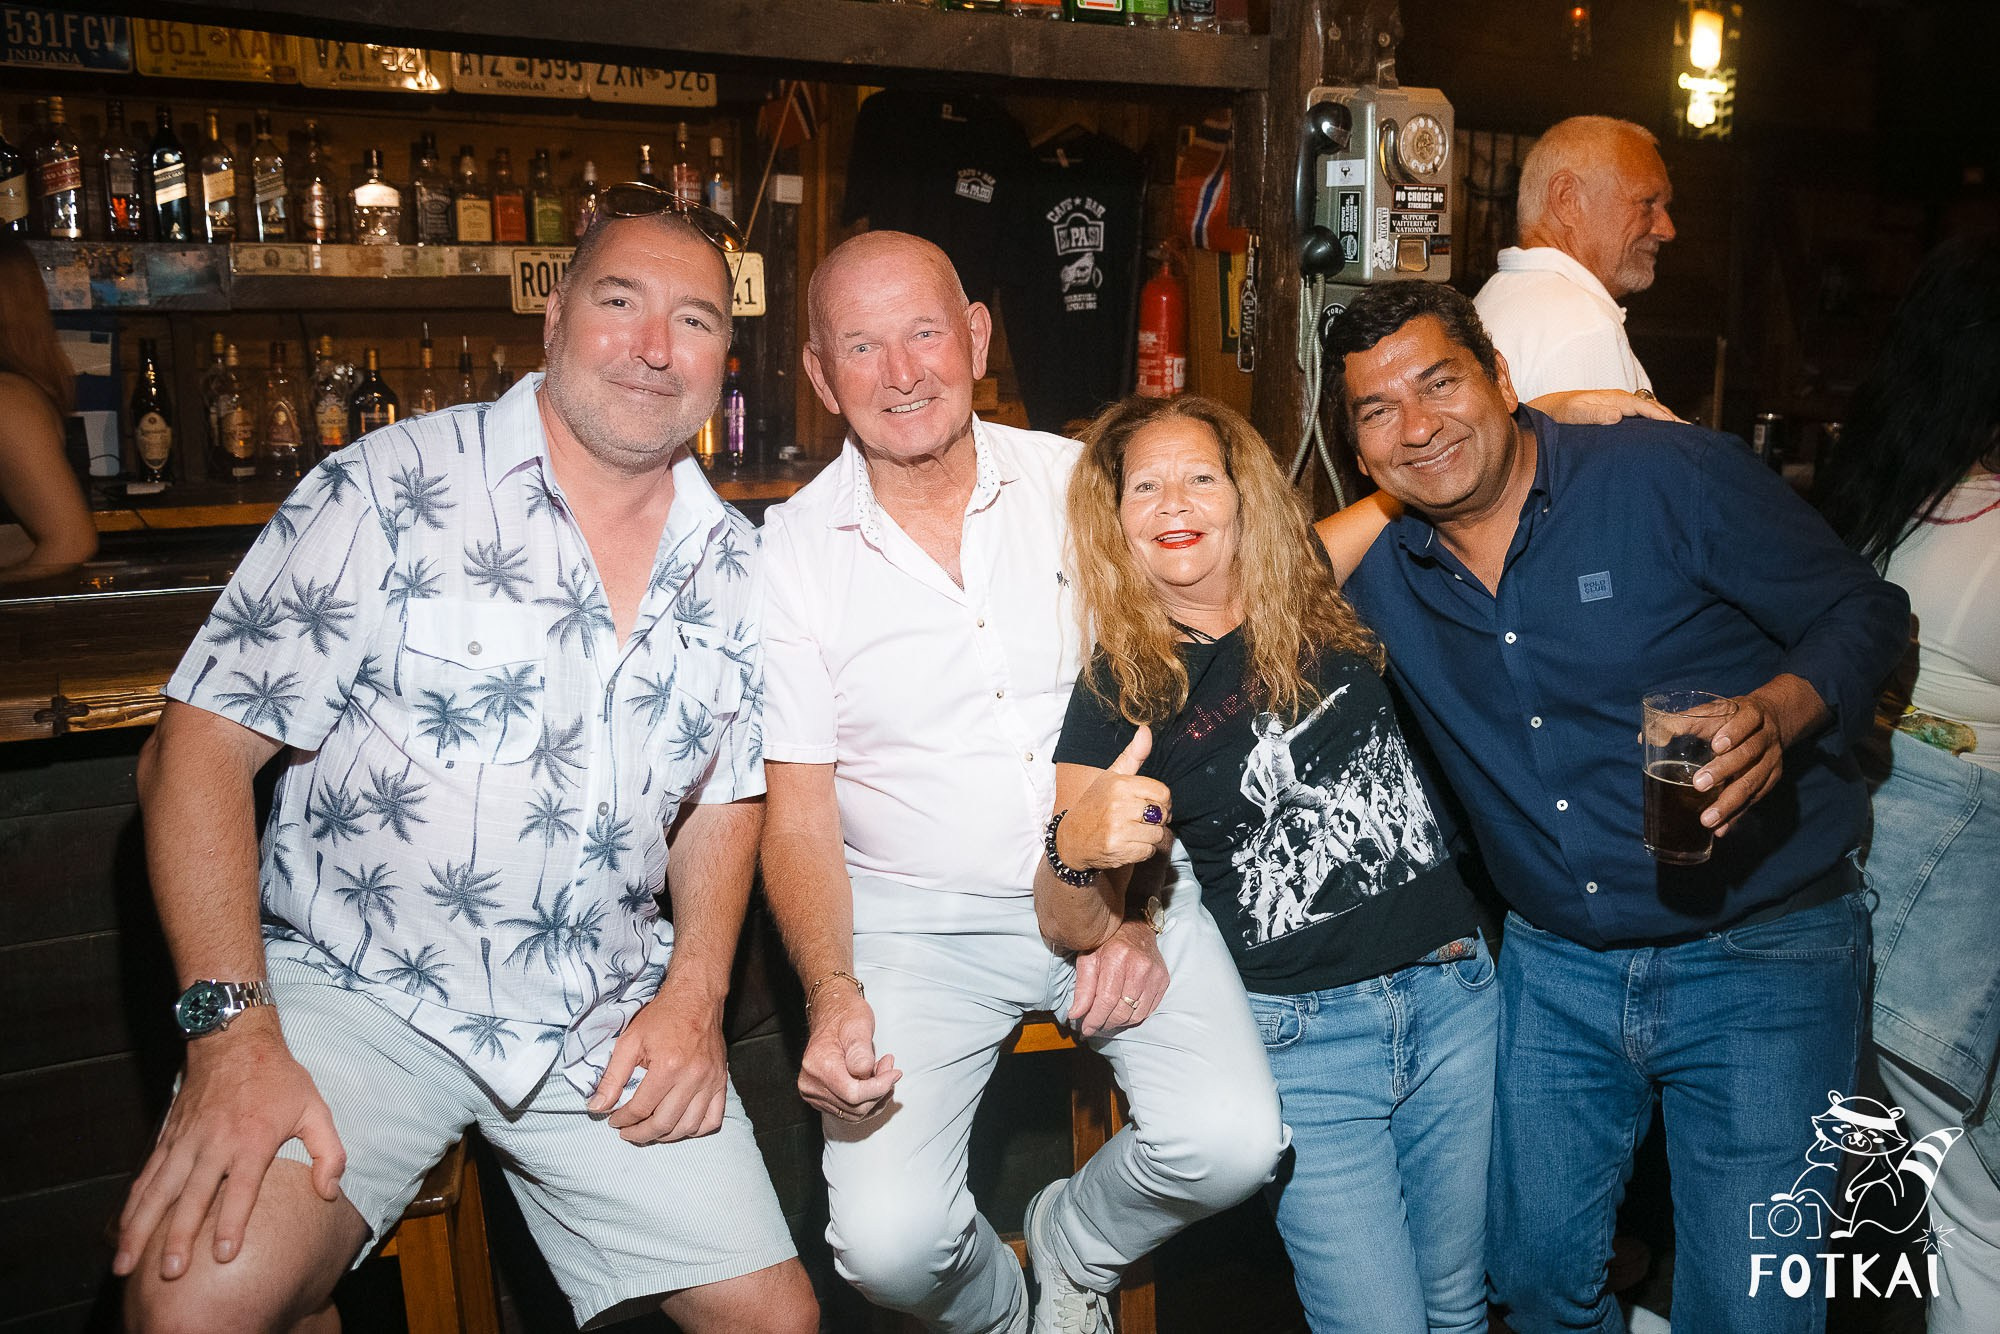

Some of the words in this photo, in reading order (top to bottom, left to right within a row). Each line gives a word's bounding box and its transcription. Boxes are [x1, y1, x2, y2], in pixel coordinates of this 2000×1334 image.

[8, 48, 81, 65] INDIANA
[496, 79, 546, 91] DOUGLAS
[1395, 191, 1406, 202] NO
[1407, 191, 1433, 202] CHOICE
[1433, 192, 1444, 203] MC
